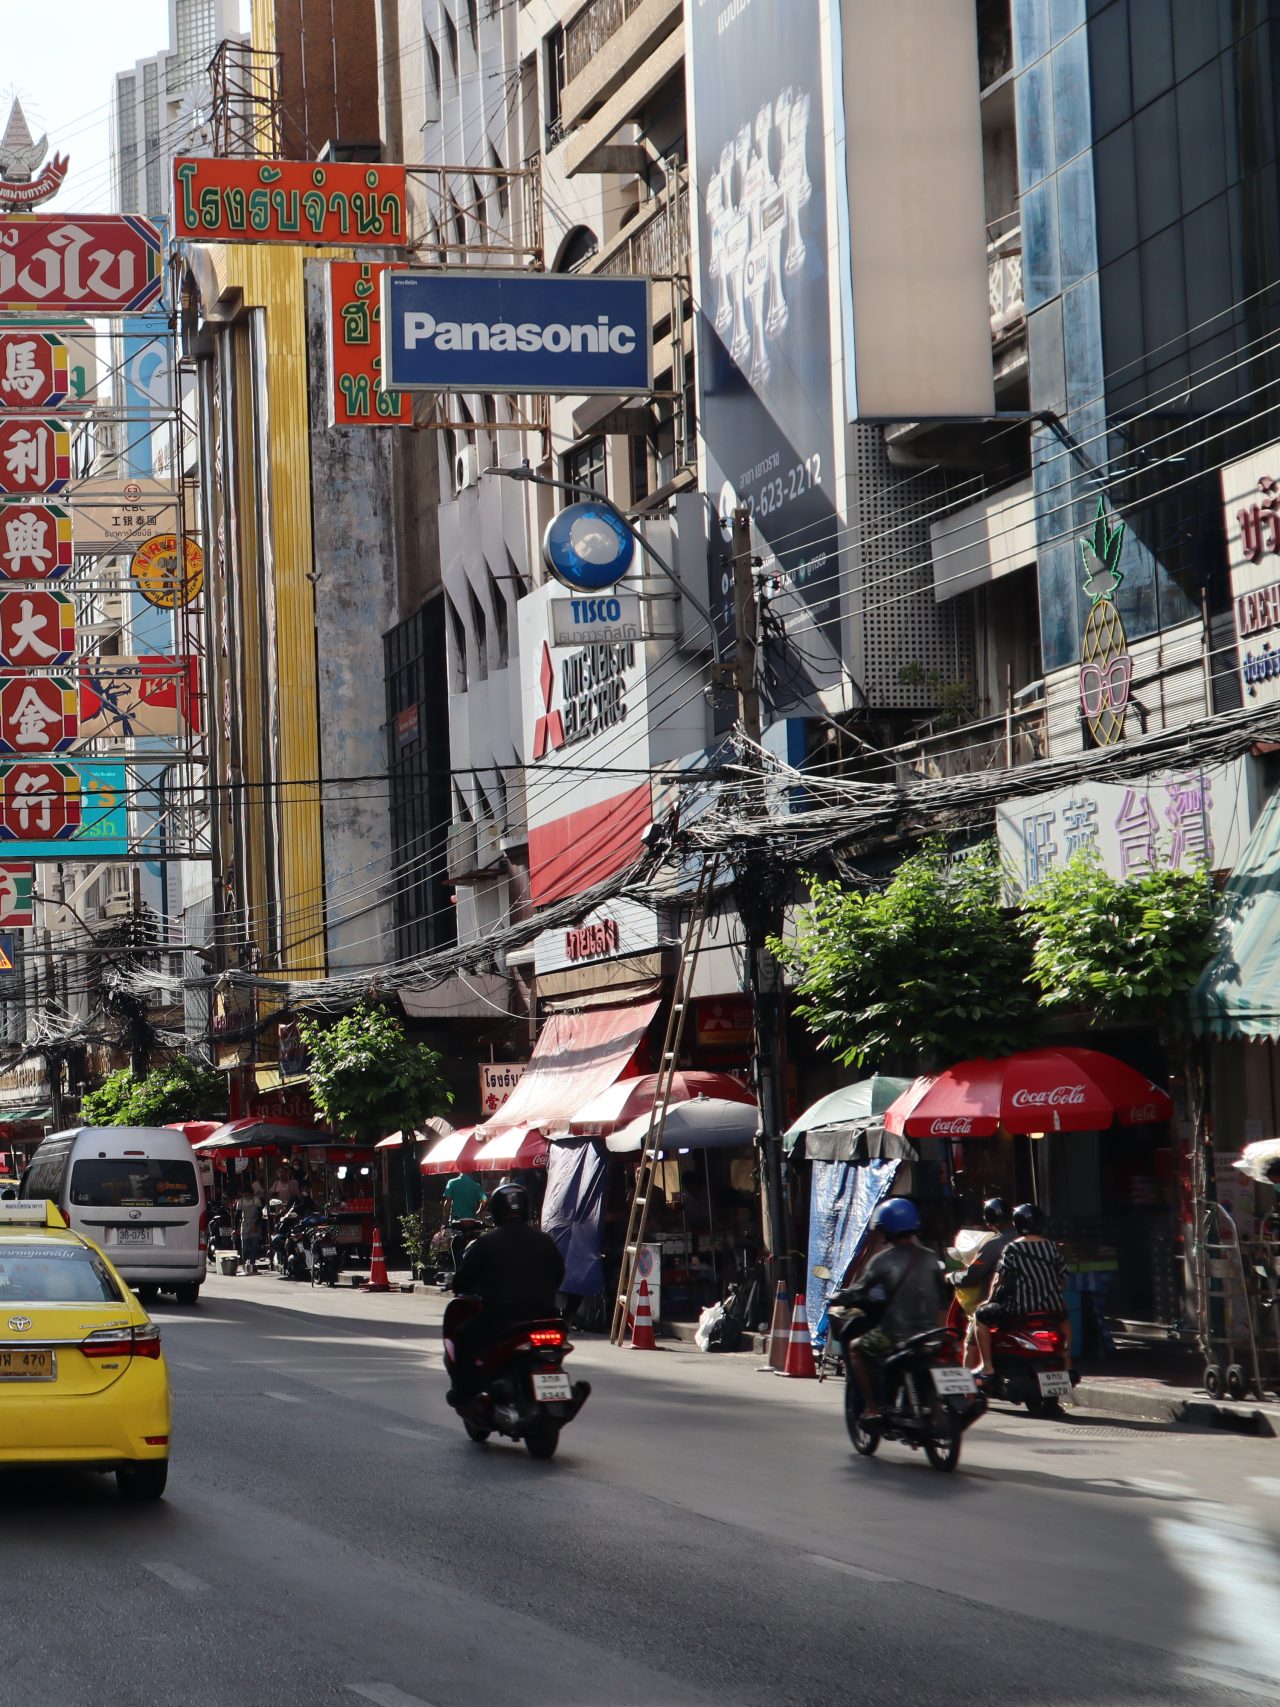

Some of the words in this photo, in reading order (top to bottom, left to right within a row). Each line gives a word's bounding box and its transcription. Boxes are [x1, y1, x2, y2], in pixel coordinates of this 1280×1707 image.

[176, 162, 403, 234] โรงรับจำนำ
[403, 311, 637, 355] Panasonic
[570, 598, 621, 624] TISCO
[562, 677, 627, 744] ELECTRIC
[1012, 1084, 1086, 1109] Coca-Cola
[930, 1116, 973, 1135] Coca-Cola
[23, 1353, 46, 1366] 470
